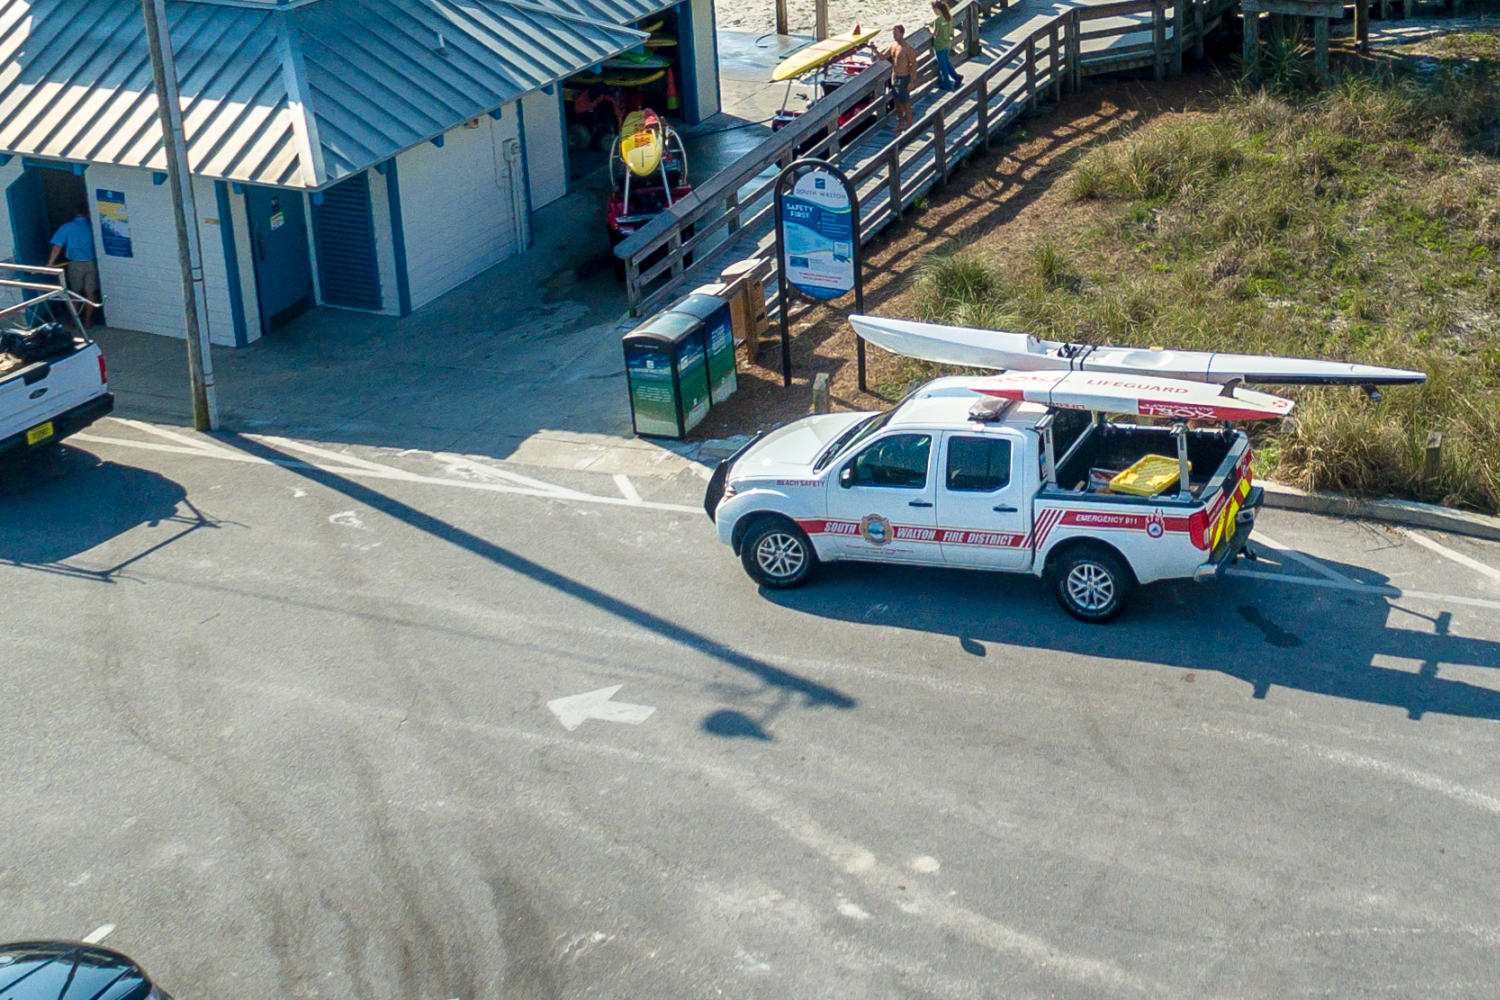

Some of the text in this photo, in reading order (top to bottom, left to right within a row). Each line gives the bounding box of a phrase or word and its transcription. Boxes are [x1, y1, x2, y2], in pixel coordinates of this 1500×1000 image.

[786, 203, 814, 212] SAFETY
[790, 210, 810, 218] FIRST
[1086, 379, 1189, 395] LIFEGUARD
[1075, 514, 1138, 525] EMERGENCY 911
[824, 521, 1015, 547] SOUTH WALTON FIRE DISTRICT
